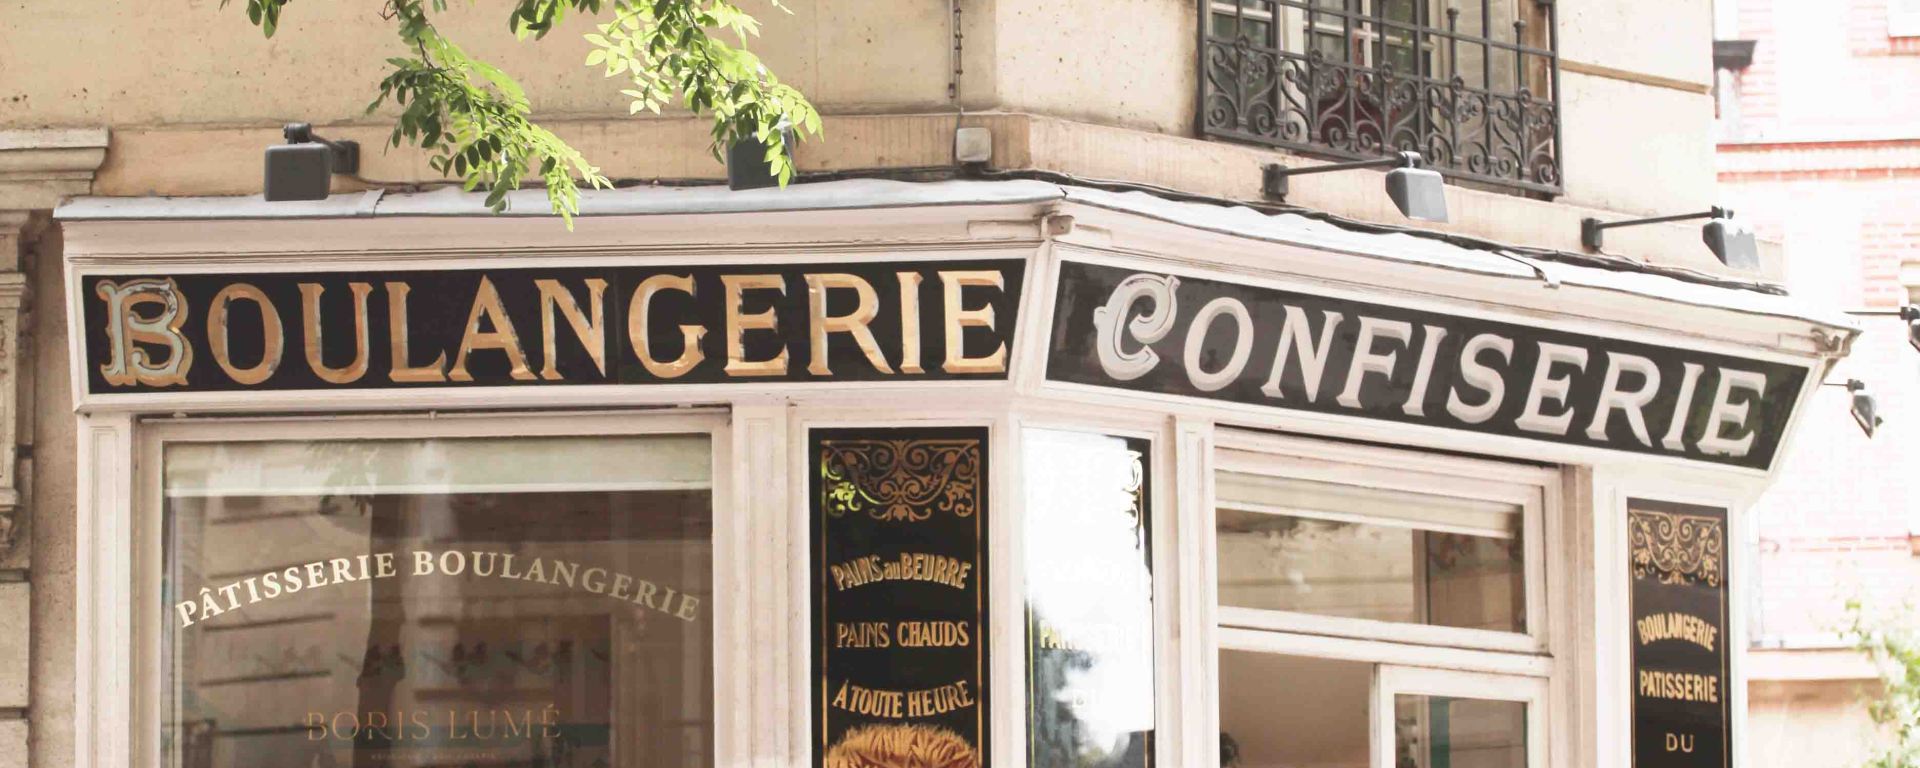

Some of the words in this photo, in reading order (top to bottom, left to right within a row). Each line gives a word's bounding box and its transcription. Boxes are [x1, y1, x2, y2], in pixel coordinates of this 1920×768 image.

[98, 269, 1008, 387] BOULANGERIE
[1094, 273, 1767, 458] CONFISERIE
[175, 552, 397, 628] PÂTISSERIE
[412, 550, 700, 622] BOULANGERIE
[830, 554, 884, 591] PAINS
[900, 552, 972, 590] BEURRE
[836, 622, 890, 648] PAINS
[897, 621, 970, 647] CHAUDS
[1637, 612, 1717, 652] BOULANGERIE
[849, 685, 903, 719] TOUTE
[907, 680, 974, 718] HEURE
[1640, 670, 1718, 702] PATISSERIE
[306, 711, 431, 740] BORIS
[449, 703, 562, 739] LUMÉ
[1665, 733, 1694, 753] DU
